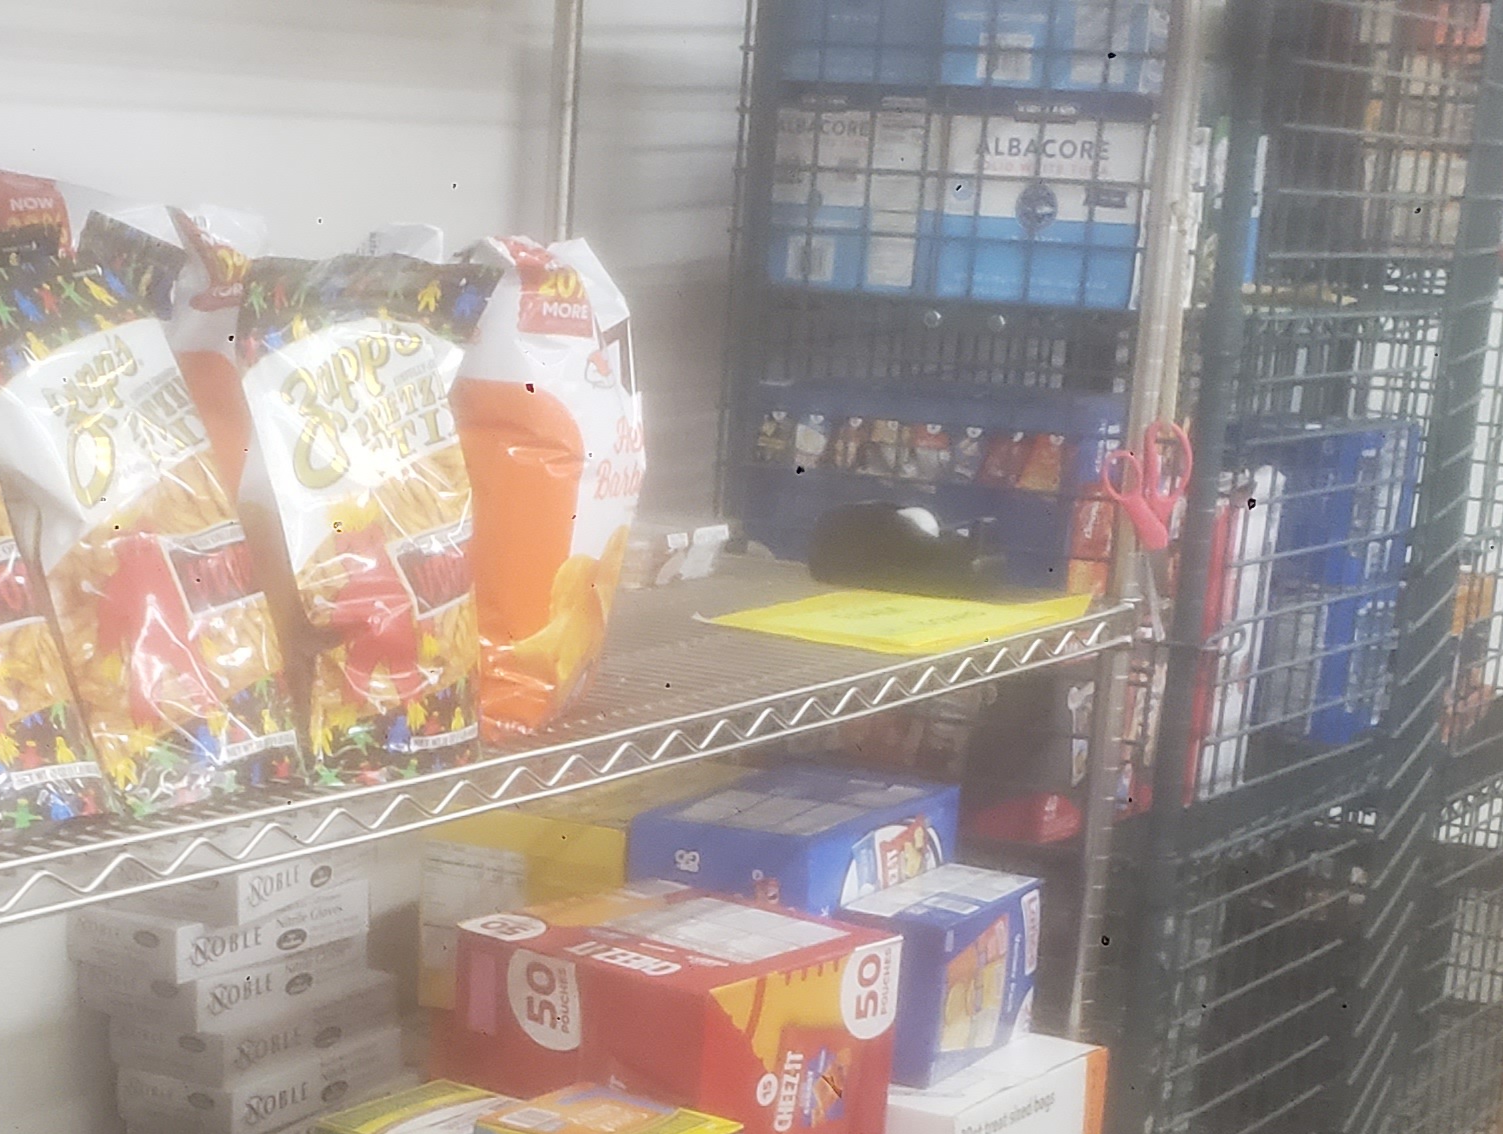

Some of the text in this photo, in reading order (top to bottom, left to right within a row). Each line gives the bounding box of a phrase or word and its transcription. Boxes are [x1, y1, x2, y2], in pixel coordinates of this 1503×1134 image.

[976, 136, 1110, 161] ALBACORE
[9, 196, 54, 212] NOW
[542, 302, 589, 319] MORE
[247, 864, 300, 908] NOBLE
[188, 925, 263, 968] NOBLE
[481, 920, 527, 939] 50
[206, 972, 273, 1017] NOBLE
[526, 960, 558, 1030] 50
[559, 965, 572, 1036] POUCHES
[856, 951, 882, 1020] 50
[881, 947, 893, 1017] POUCHES
[244, 1080, 308, 1127] NOBLE
[1034, 1091, 1056, 1114] bags
